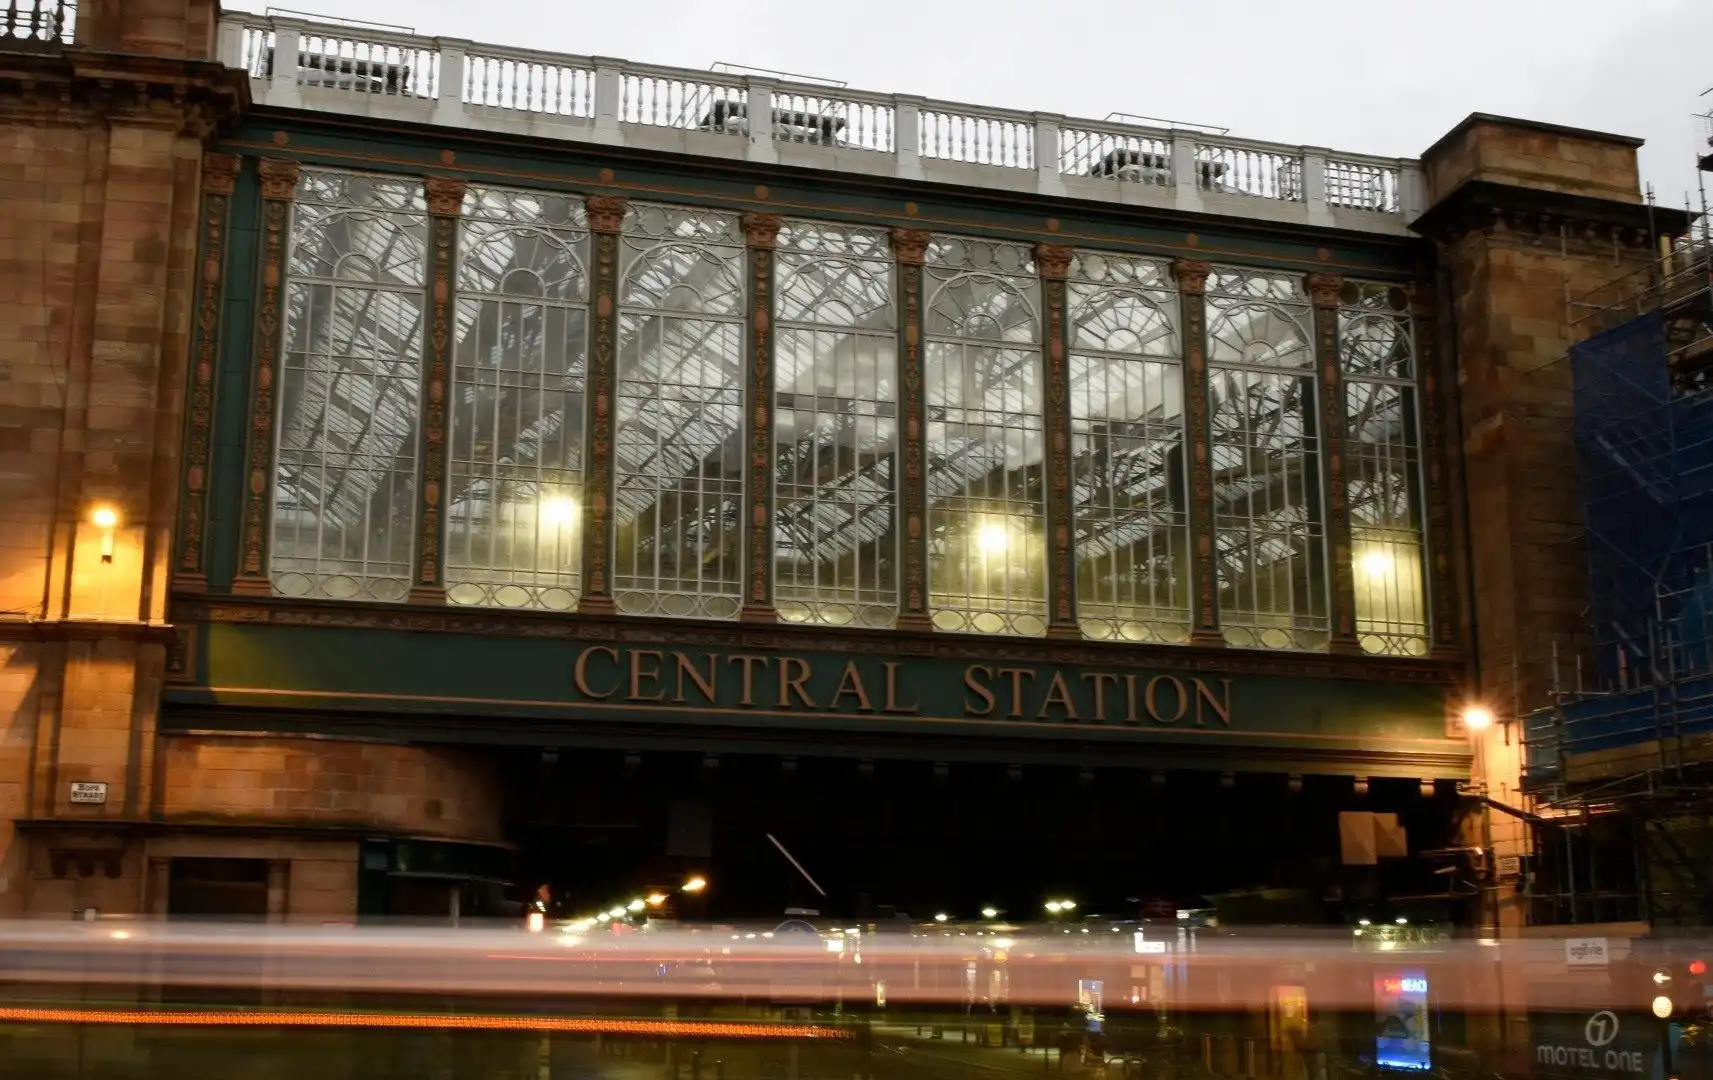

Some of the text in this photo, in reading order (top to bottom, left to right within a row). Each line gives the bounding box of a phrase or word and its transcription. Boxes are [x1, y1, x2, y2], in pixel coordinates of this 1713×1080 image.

[573, 645, 1233, 726] CENTRAL STATION
[1536, 1045, 1644, 1072] MOTEL ONE
